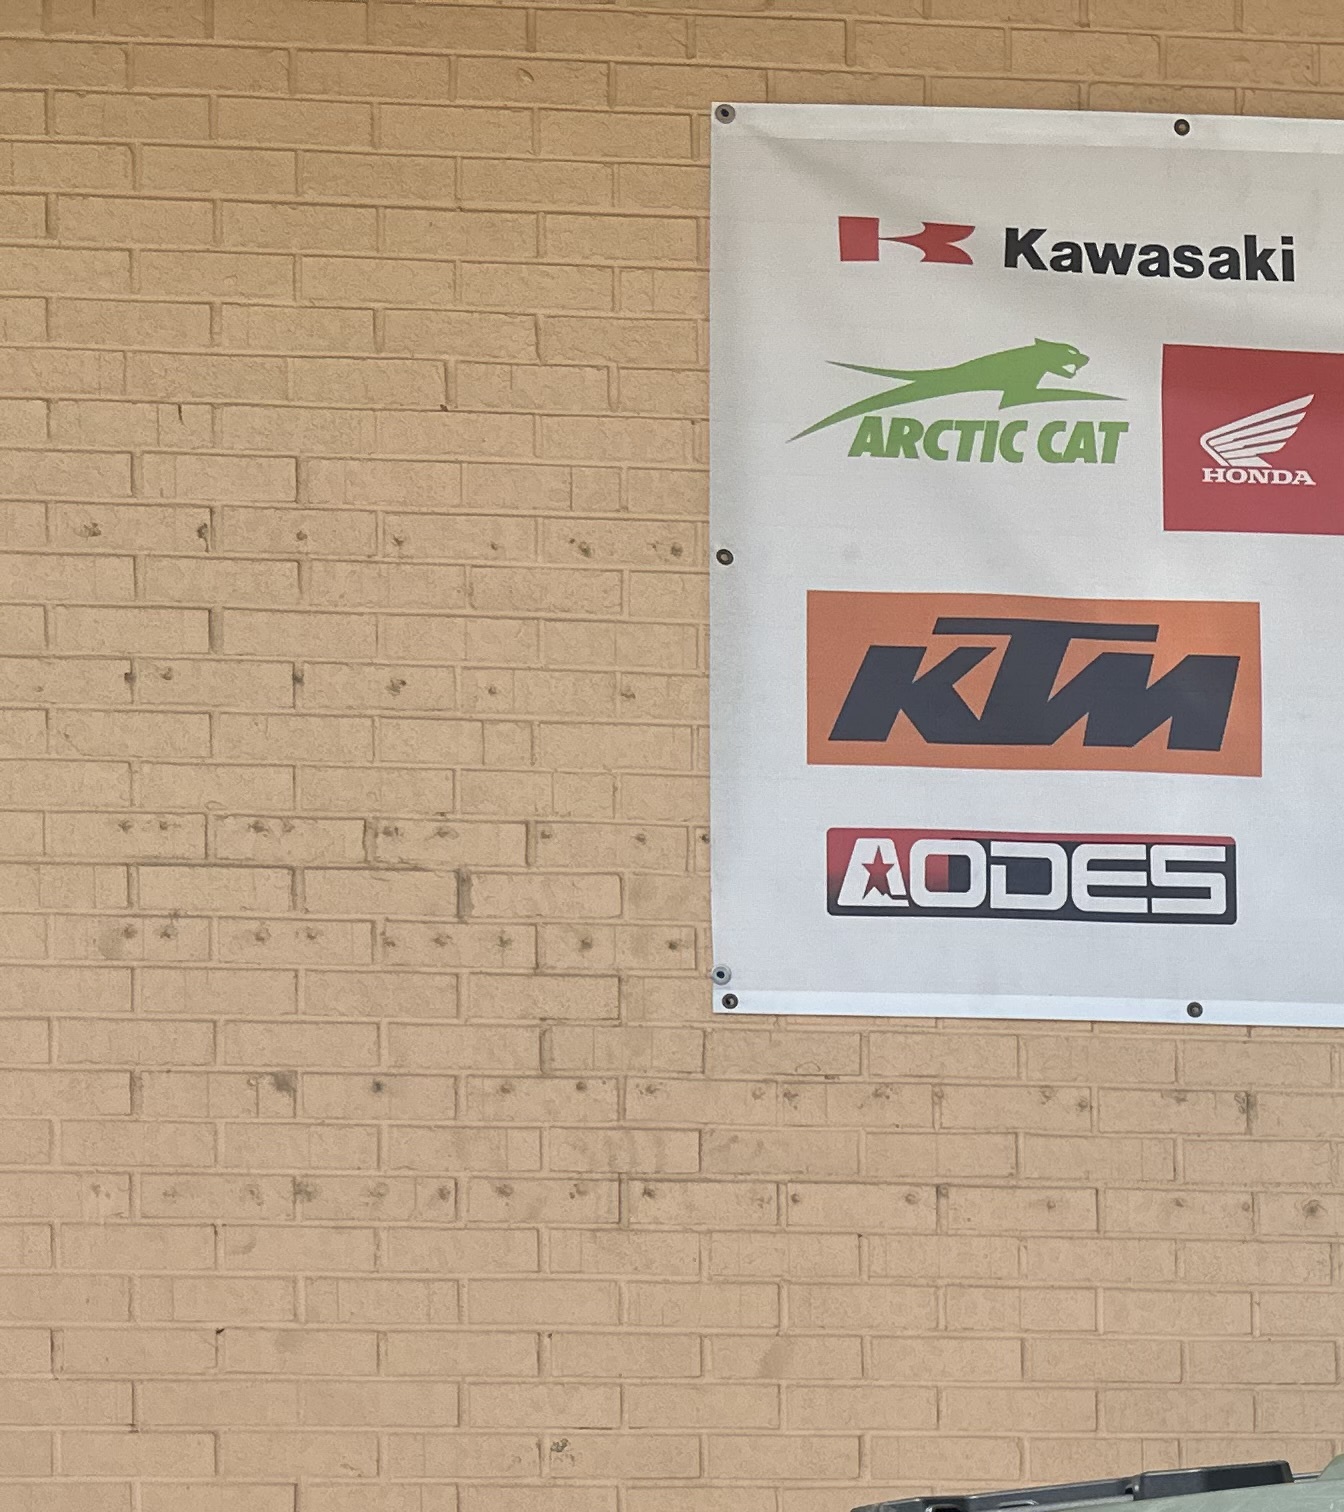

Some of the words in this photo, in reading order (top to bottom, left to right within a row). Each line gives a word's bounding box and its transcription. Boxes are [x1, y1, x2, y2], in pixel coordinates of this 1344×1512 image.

[1003, 227, 1295, 283] Kawasaki
[847, 416, 1029, 463] ARCTIC
[1036, 420, 1129, 465] CAT
[1201, 467, 1316, 486] HONDA
[828, 617, 1241, 751] KTM
[837, 838, 1228, 914] AODES
